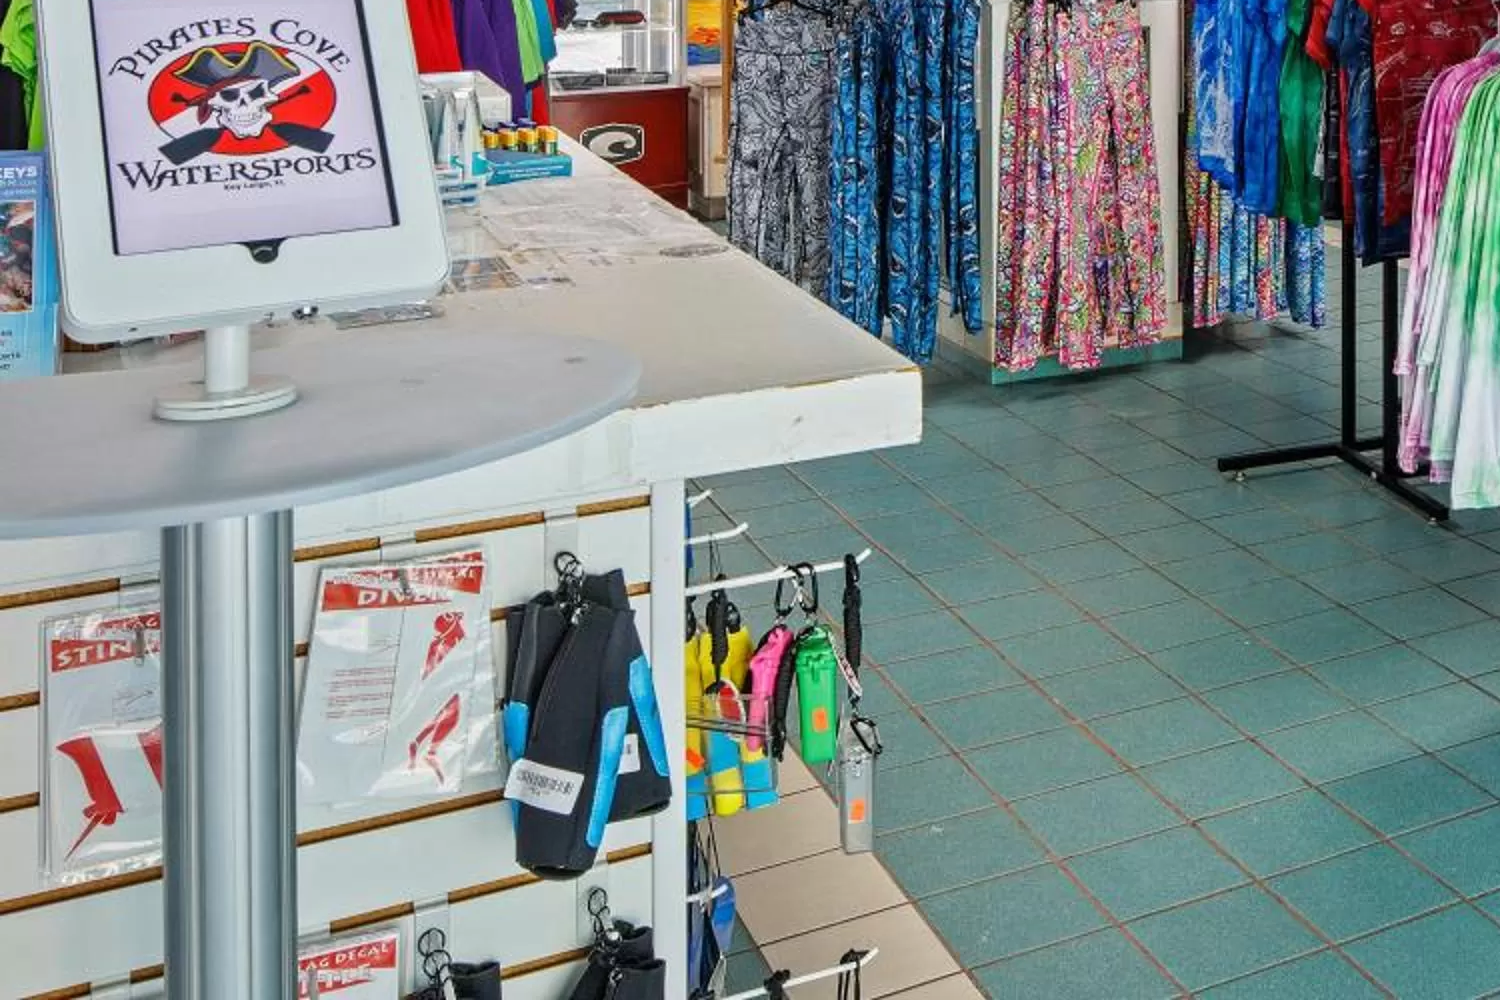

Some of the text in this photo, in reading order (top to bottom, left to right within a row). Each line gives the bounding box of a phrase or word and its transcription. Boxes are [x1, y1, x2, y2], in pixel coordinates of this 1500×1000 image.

[108, 17, 351, 80] PIRATES COVE
[0, 165, 38, 179] EYS
[117, 148, 377, 192] WATERSPORTS
